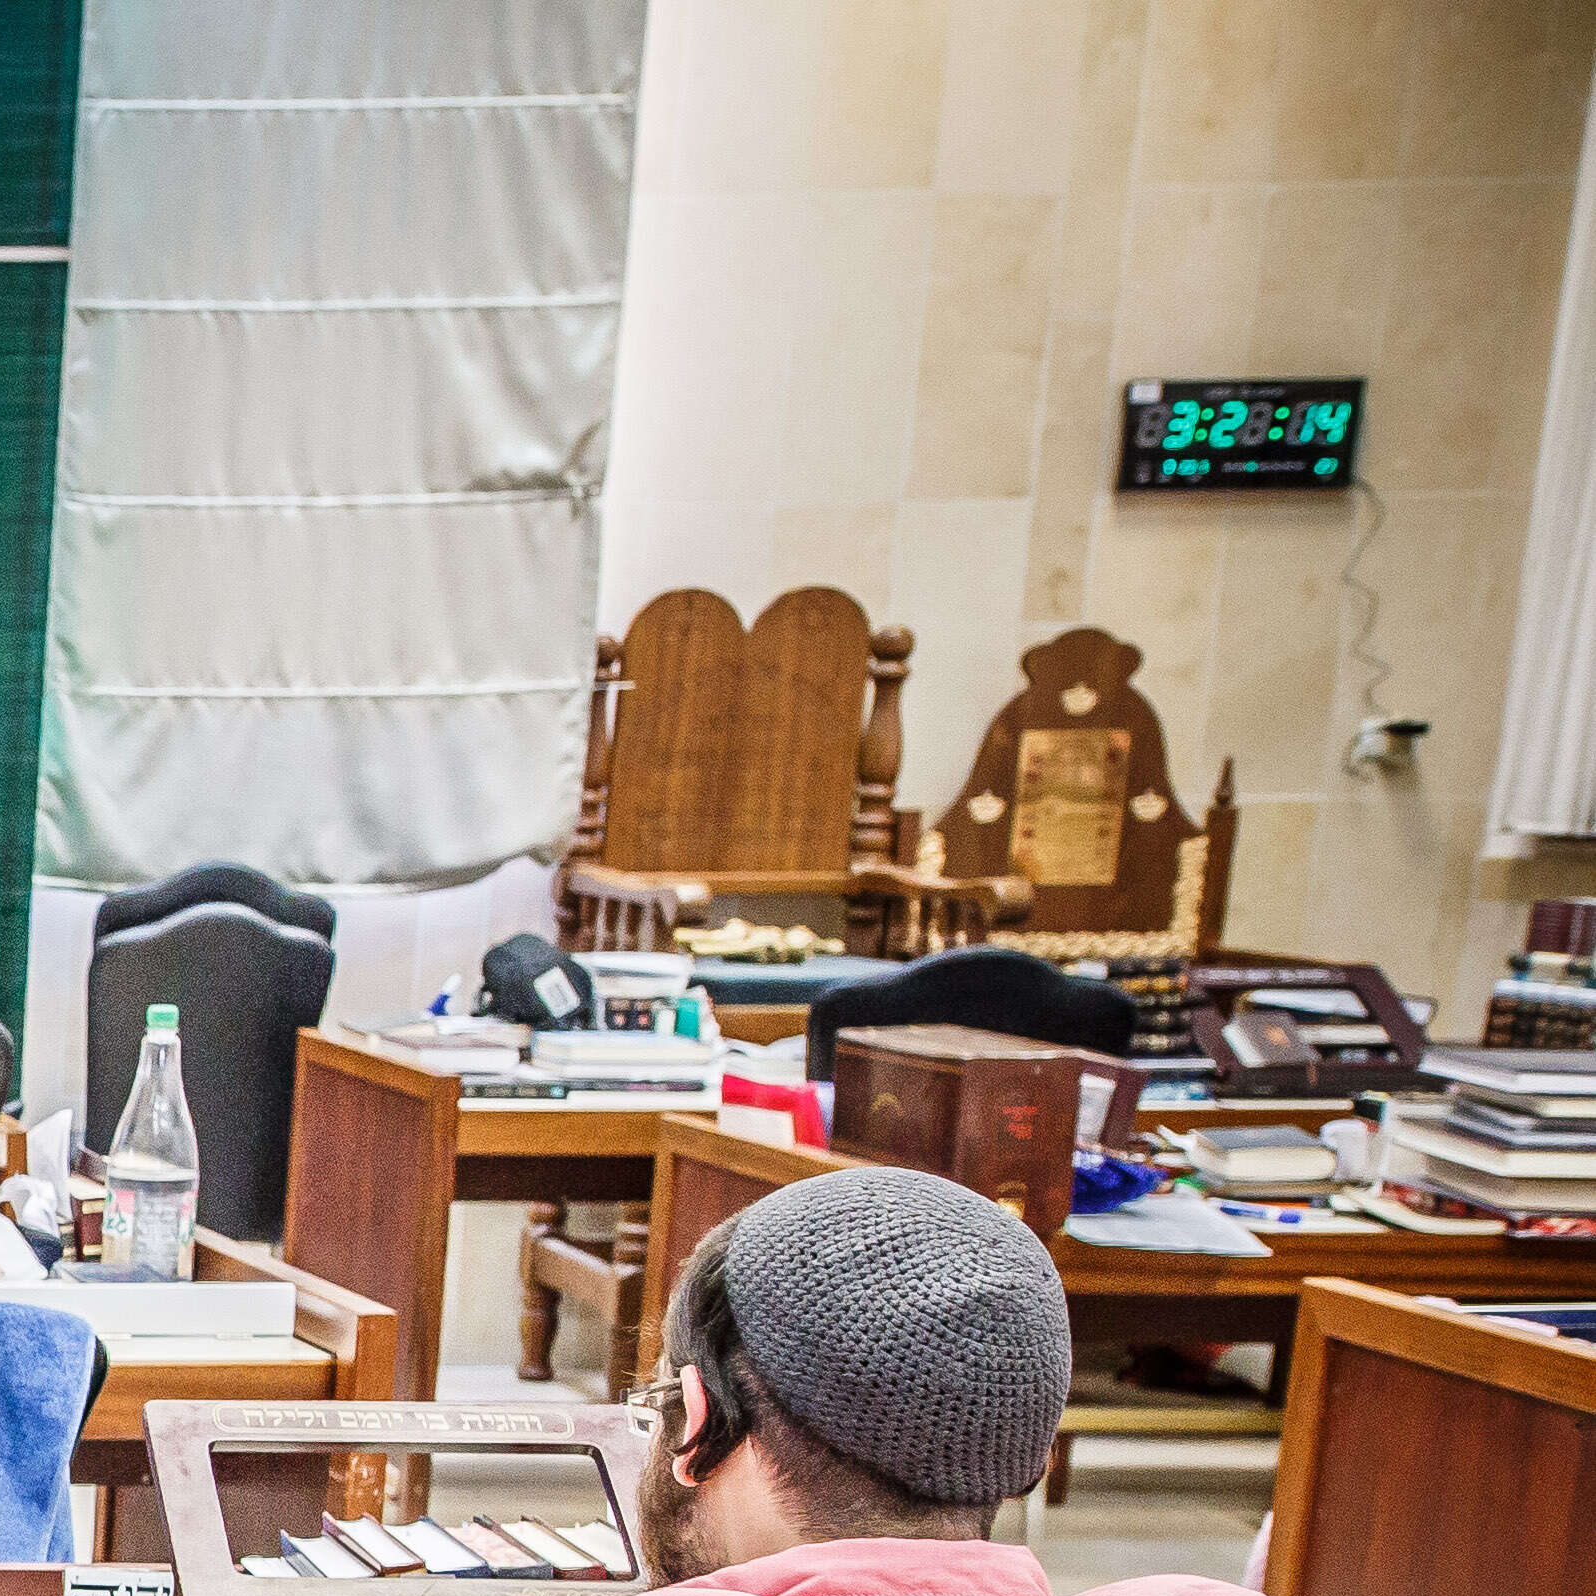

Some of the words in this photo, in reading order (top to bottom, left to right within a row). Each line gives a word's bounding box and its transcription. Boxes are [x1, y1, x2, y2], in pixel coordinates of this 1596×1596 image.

[241, 1407, 327, 1428] ולילה
[337, 1409, 404, 1431] יומם
[416, 1411, 450, 1430] בו
[461, 1411, 544, 1433] והגית
